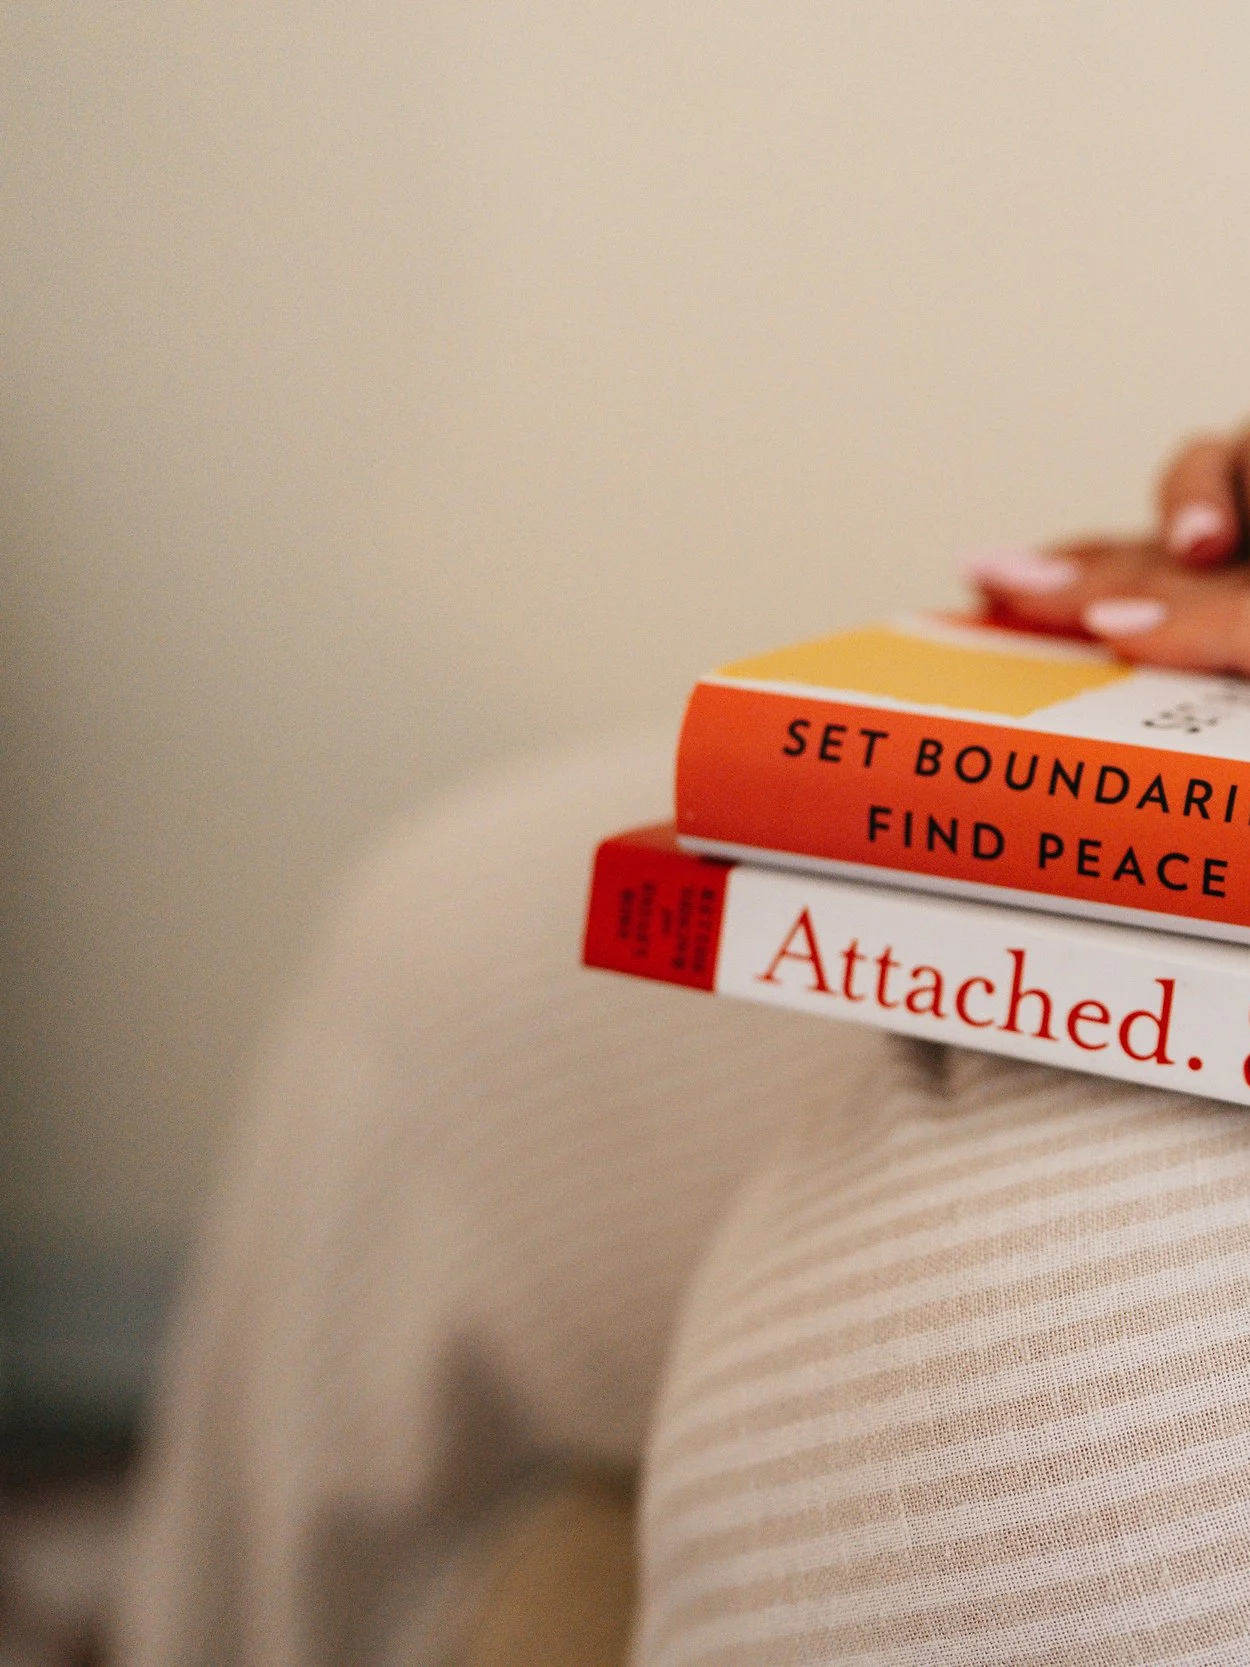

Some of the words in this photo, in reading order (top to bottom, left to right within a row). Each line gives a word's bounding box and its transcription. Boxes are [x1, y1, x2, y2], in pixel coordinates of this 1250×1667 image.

[784, 719, 889, 767] SET
[867, 806, 1004, 860] FIND
[1038, 833, 1229, 898] PEACE
[757, 906, 1203, 1071] Attached.
